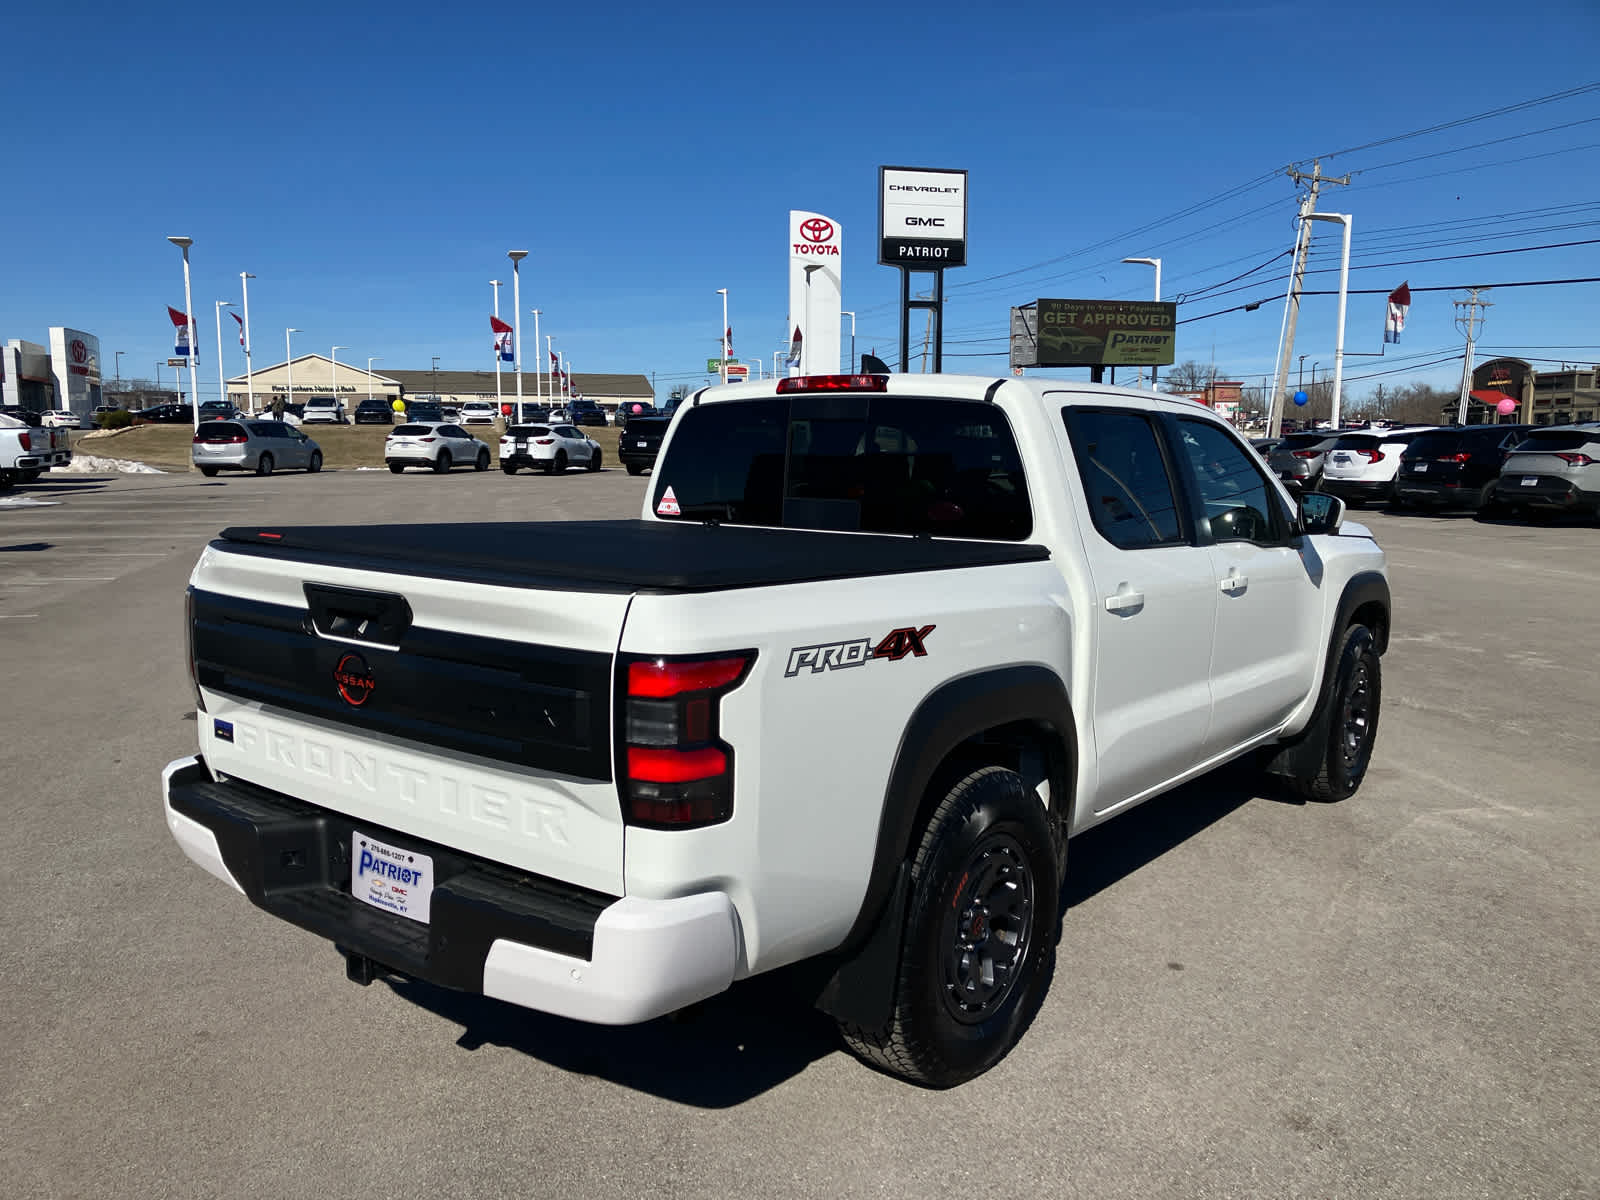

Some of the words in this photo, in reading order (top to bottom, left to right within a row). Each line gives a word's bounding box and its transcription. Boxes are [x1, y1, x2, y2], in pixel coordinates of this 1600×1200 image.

[889, 184, 960, 194] CHEVROLET
[905, 217, 945, 227] GMC
[793, 244, 839, 255] TOYOTA
[899, 246, 950, 258] PATRIOT
[1043, 312, 1078, 324] GET
[1083, 313, 1171, 327] APPROVED
[1112, 333, 1170, 349] PATRIOT
[236, 719, 571, 846] FRONTIER
[358, 849, 422, 886] PATRIOT
